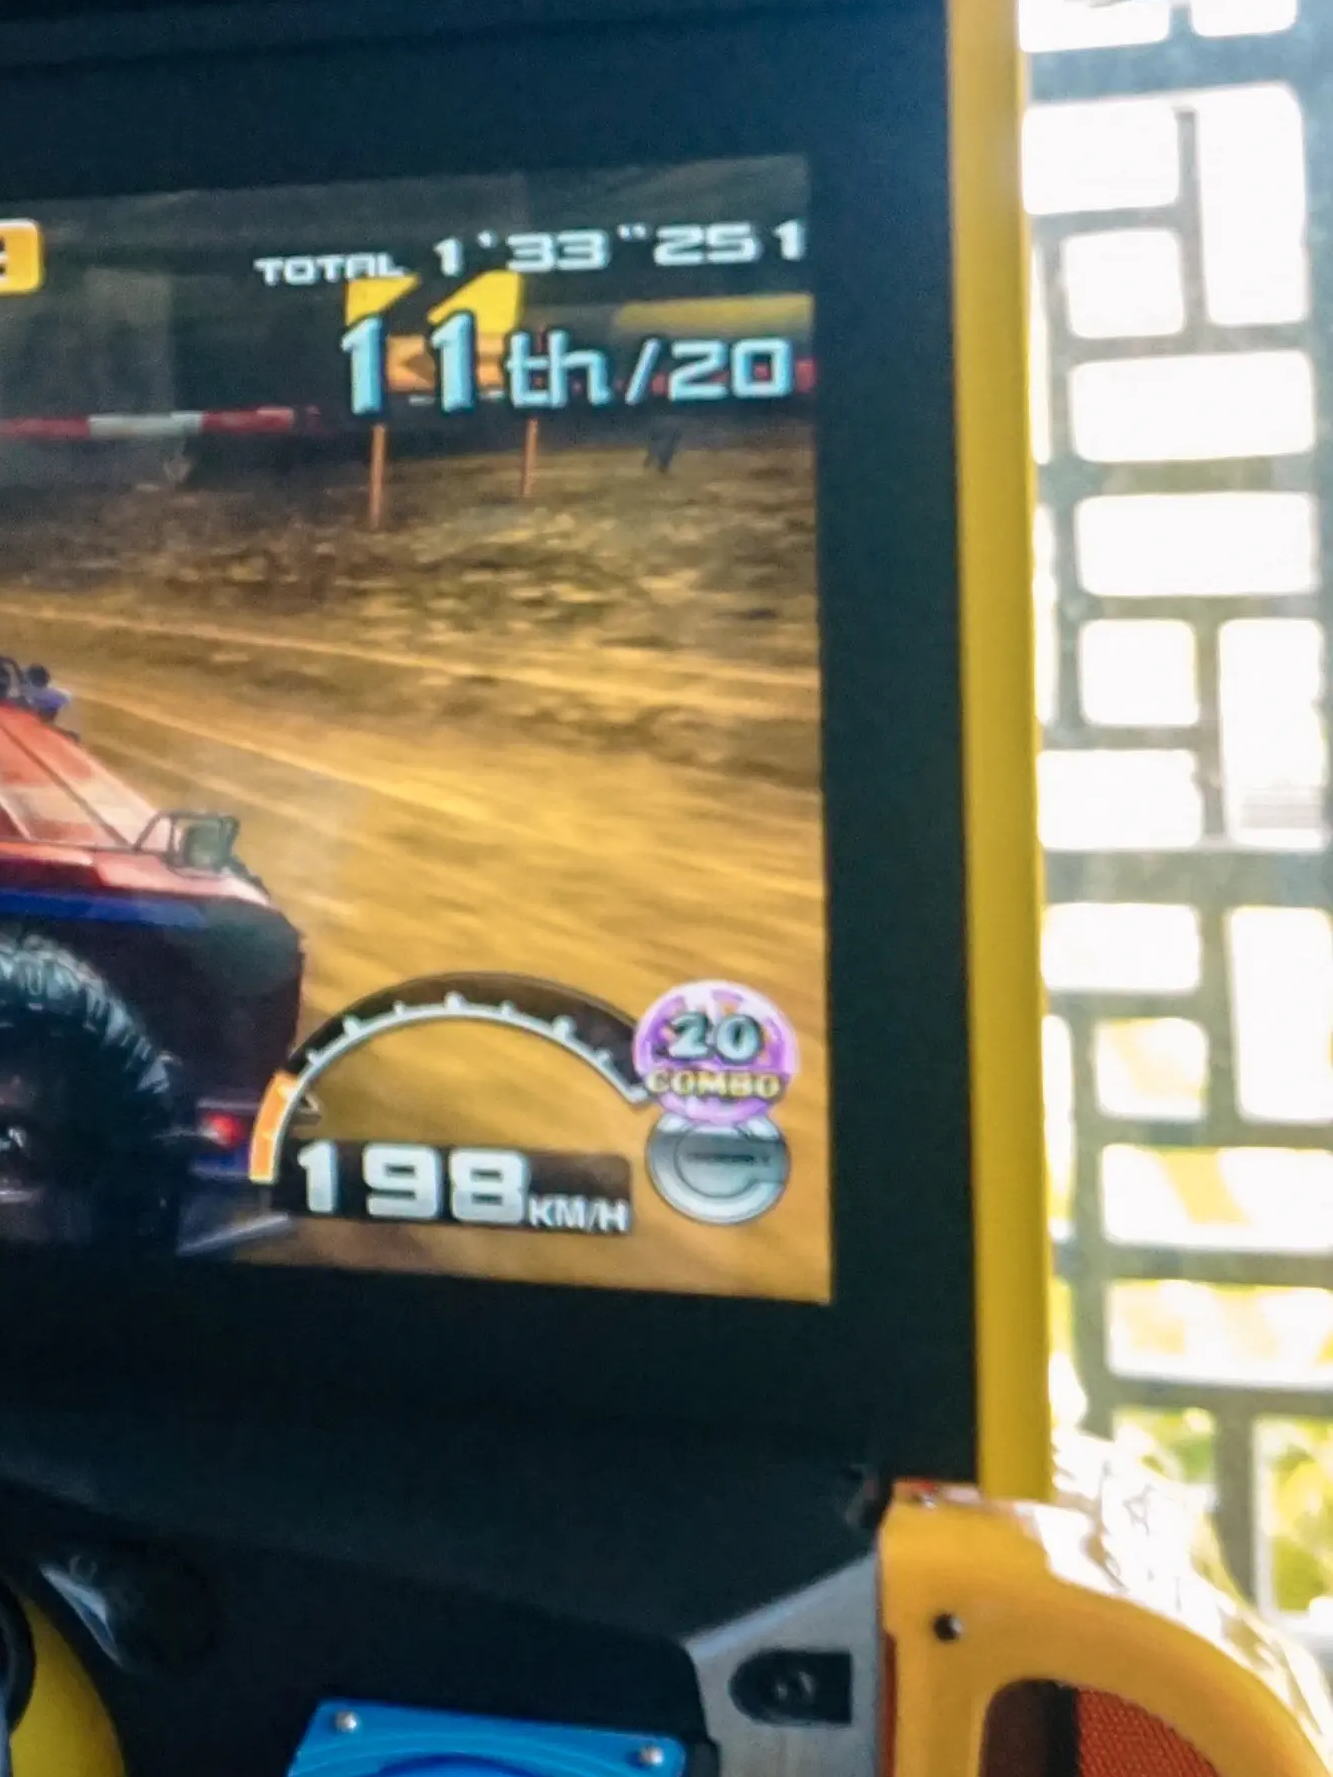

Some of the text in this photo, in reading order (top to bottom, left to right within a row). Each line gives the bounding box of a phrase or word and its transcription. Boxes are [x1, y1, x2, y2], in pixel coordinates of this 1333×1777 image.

[254, 252, 411, 286] TOTAL
[668, 1012, 763, 1062] 20
[646, 1069, 782, 1102] COMBO
[296, 1139, 629, 1235] 198 KM/H
